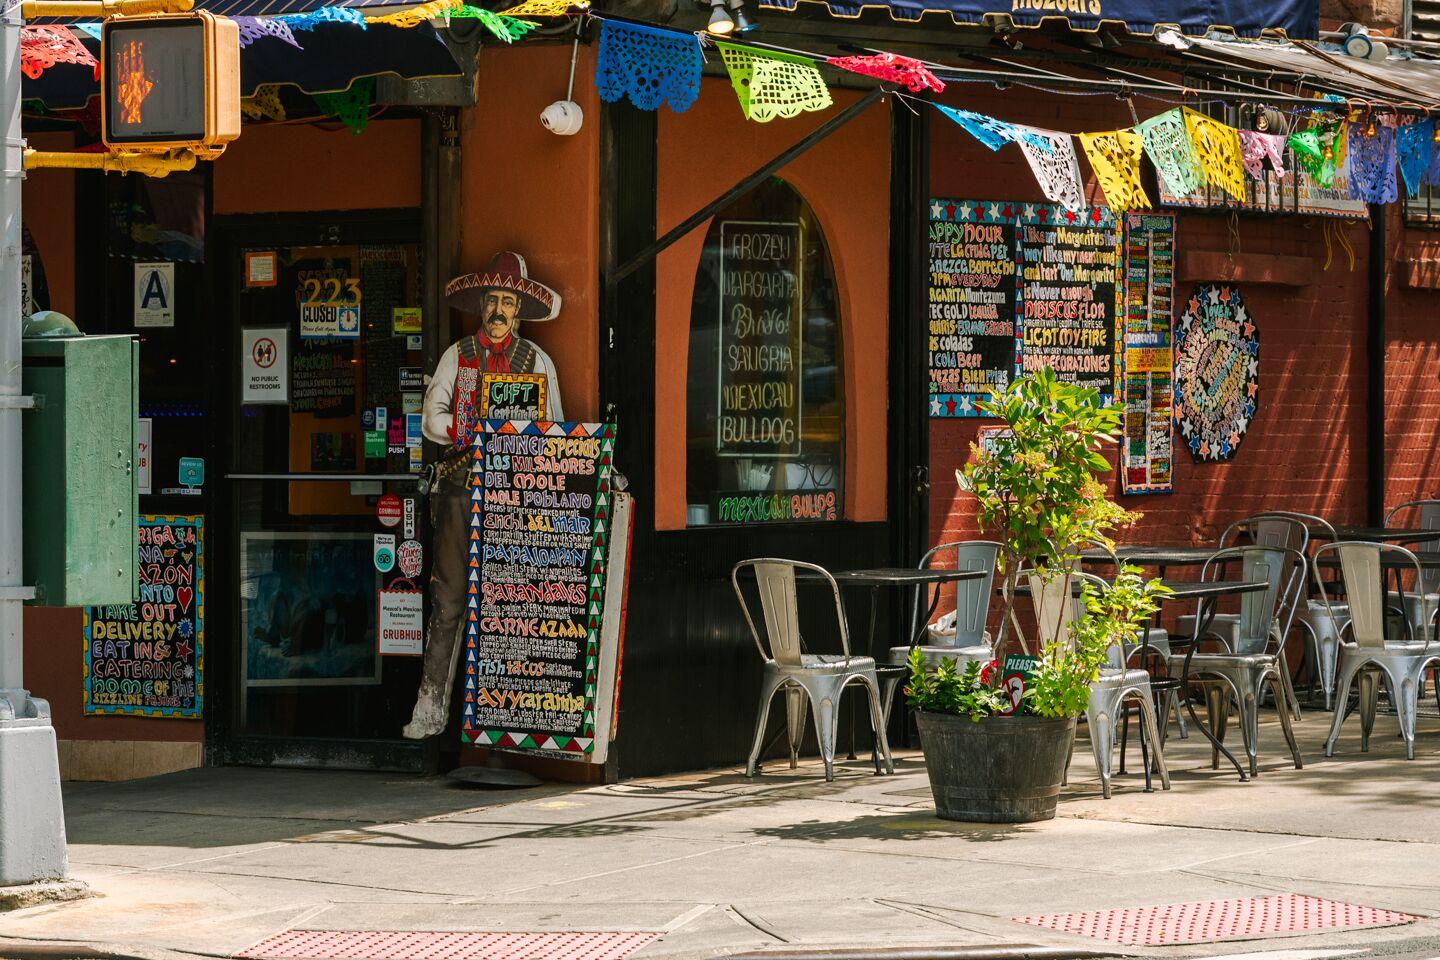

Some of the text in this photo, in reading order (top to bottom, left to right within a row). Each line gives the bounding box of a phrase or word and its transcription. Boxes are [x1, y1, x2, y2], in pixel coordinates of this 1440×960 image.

[141, 270, 168, 308] A
[303, 277, 363, 308] 223
[303, 304, 337, 323] CLOSED
[944, 304, 967, 320] GOLD
[729, 344, 794, 372] SANGRIA
[490, 382, 534, 405] GIFT
[723, 417, 795, 444] BULLDOG
[485, 455, 511, 471] LOS
[484, 471, 511, 489] DEL
[483, 490, 521, 507] MOLE
[405, 499, 414, 528] PUSH
[96, 604, 178, 622] TAKE OUT
[93, 621, 178, 641] DELIVERY
[383, 629, 422, 640] GRUBHUB
[93, 640, 130, 659] EAT
[92, 658, 185, 680] CATERING
